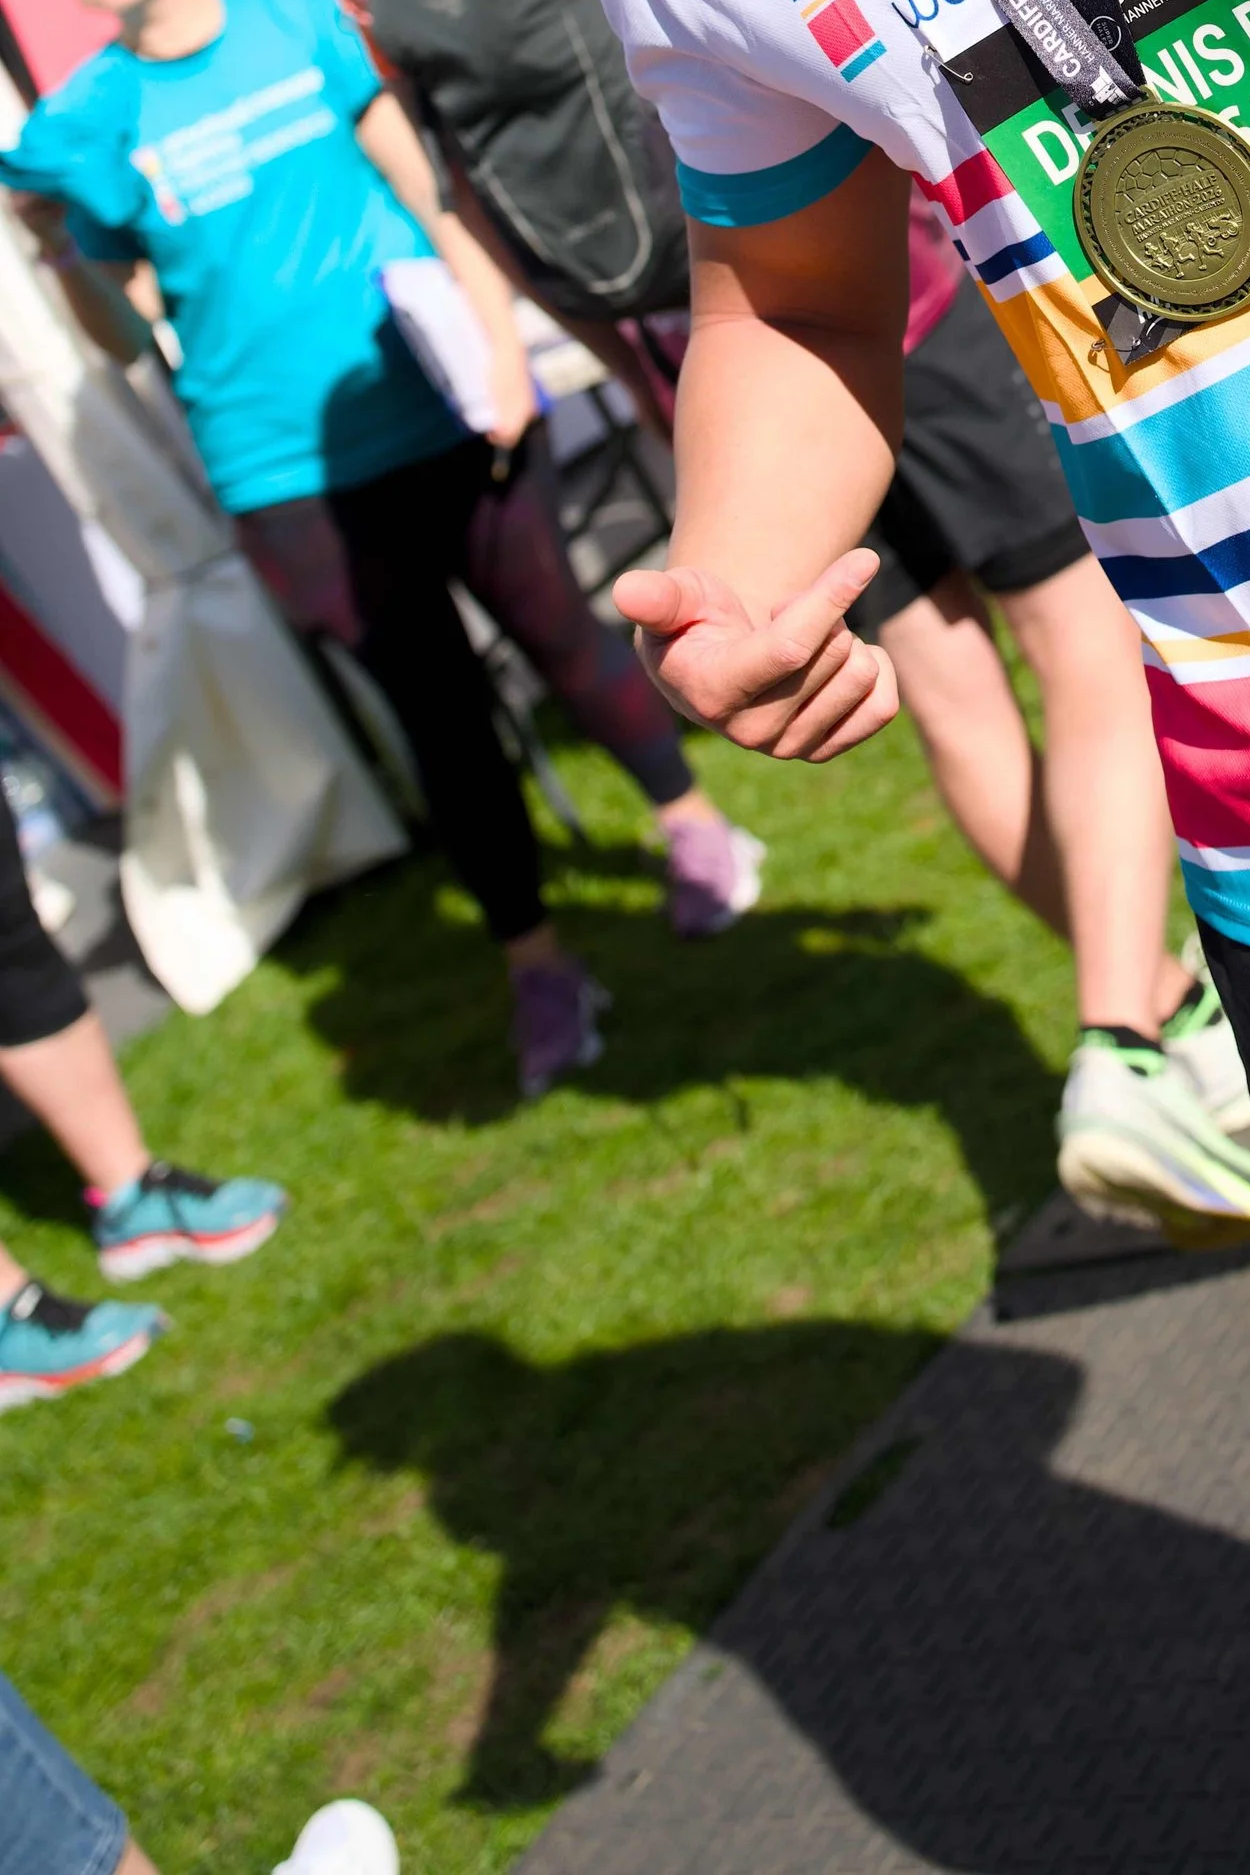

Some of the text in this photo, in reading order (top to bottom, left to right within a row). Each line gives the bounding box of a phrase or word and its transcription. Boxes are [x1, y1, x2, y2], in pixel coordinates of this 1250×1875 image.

[1062, 23, 1095, 63] HANNER
[1021, 23, 1245, 186] DENIS
[1124, 188, 1179, 225] CARDIFF
[1132, 198, 1193, 235] MARATHON
